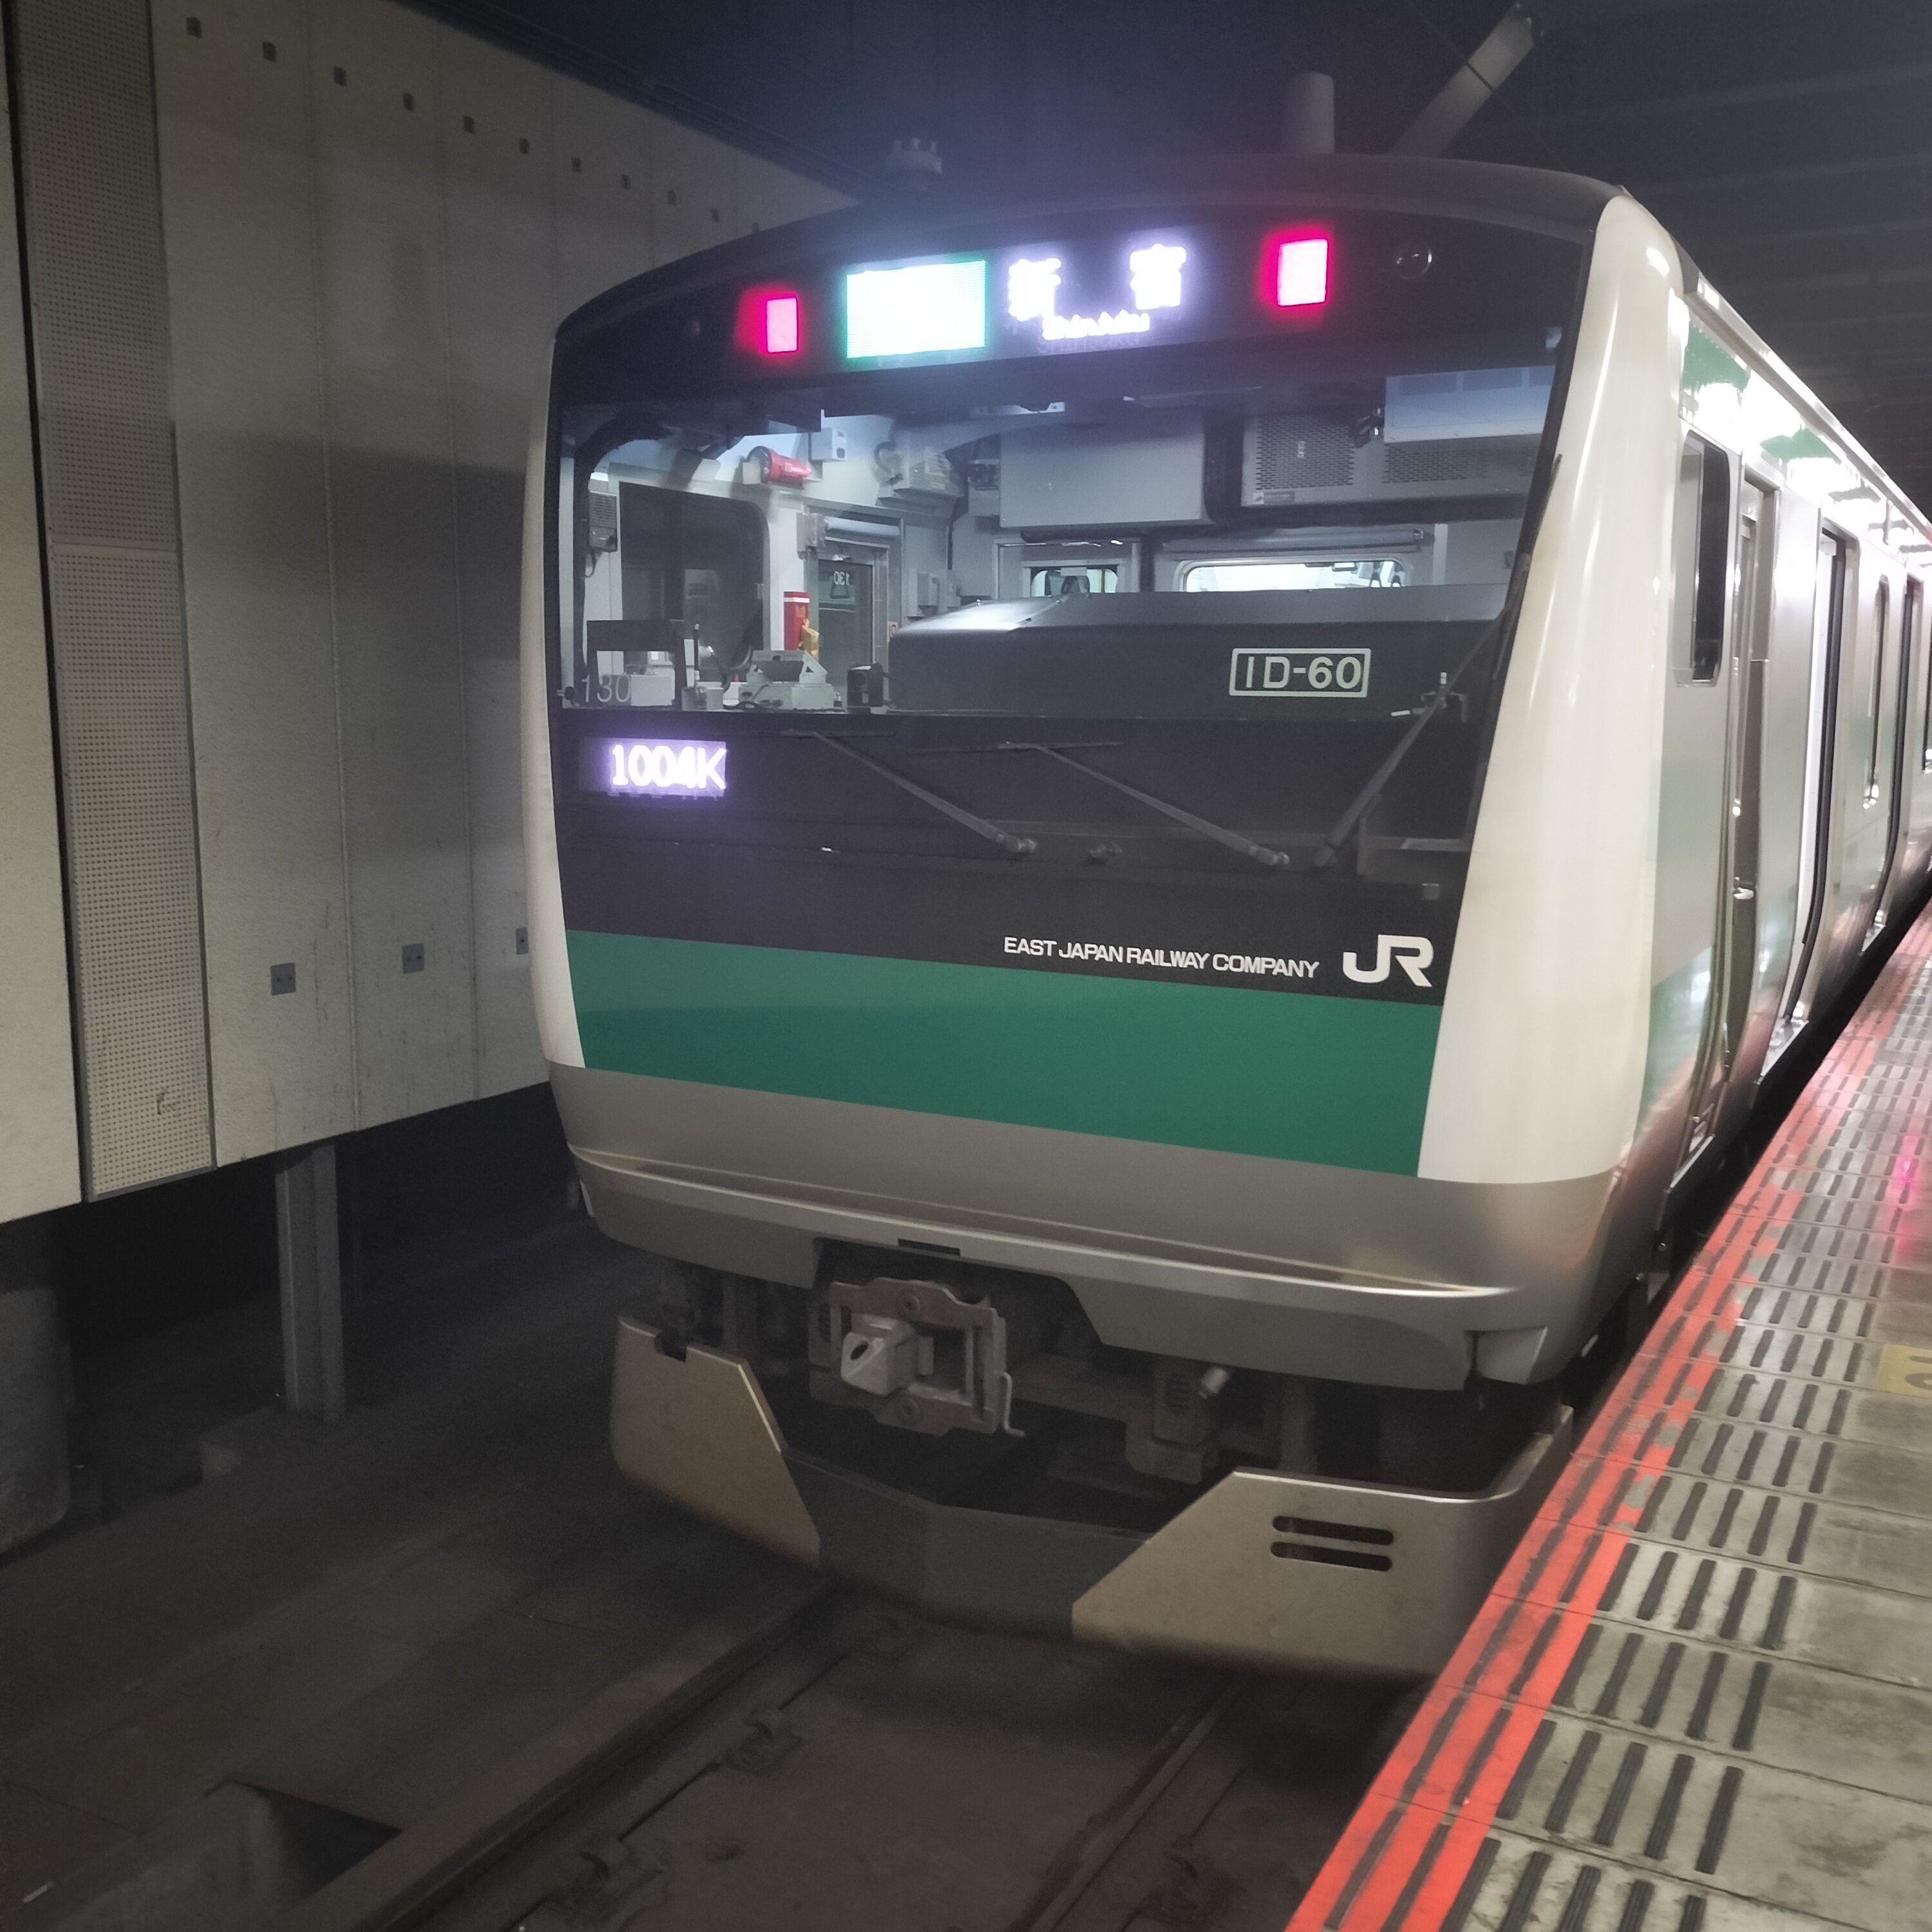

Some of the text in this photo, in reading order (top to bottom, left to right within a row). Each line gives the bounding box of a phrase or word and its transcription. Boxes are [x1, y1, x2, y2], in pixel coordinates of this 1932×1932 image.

[581, 672, 631, 703] 130
[1245, 656, 1362, 690] ID-60
[612, 744, 726, 790] 1004K
[1004, 936, 1320, 978] EAST JAPAN RAILWAY COMPANY
[1342, 934, 1434, 987] JR
